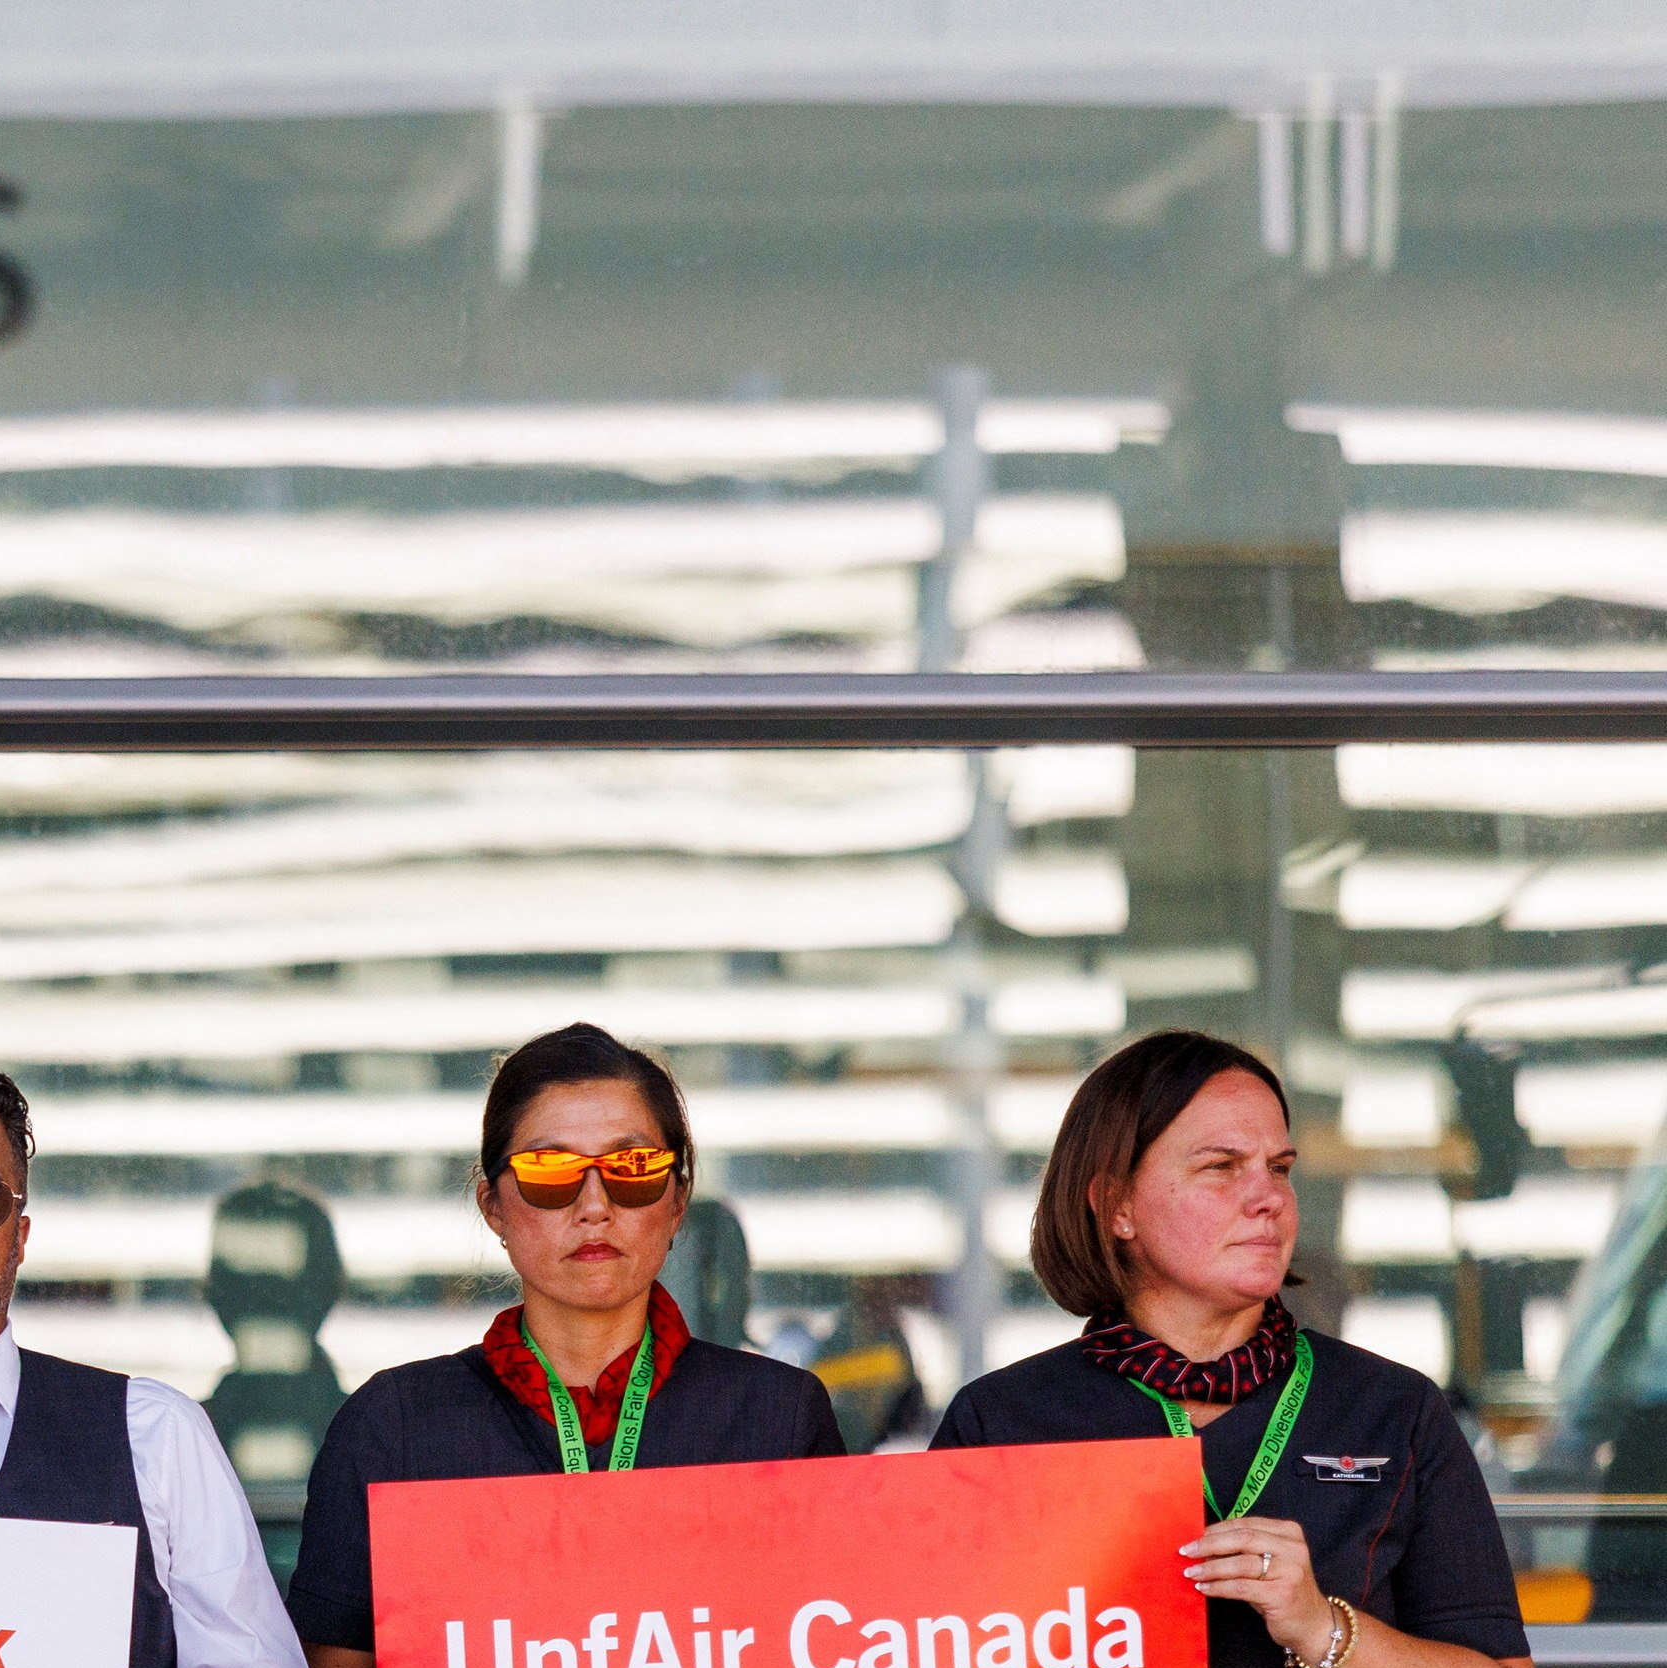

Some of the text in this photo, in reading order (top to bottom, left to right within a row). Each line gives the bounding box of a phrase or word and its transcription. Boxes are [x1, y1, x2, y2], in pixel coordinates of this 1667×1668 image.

[556, 1395, 578, 1443] Contrat
[624, 1391, 646, 1421] Fair
[1234, 1496, 1251, 1518] No
[1247, 1455, 1274, 1496] More
[1265, 1381, 1306, 1454] Diversions.
